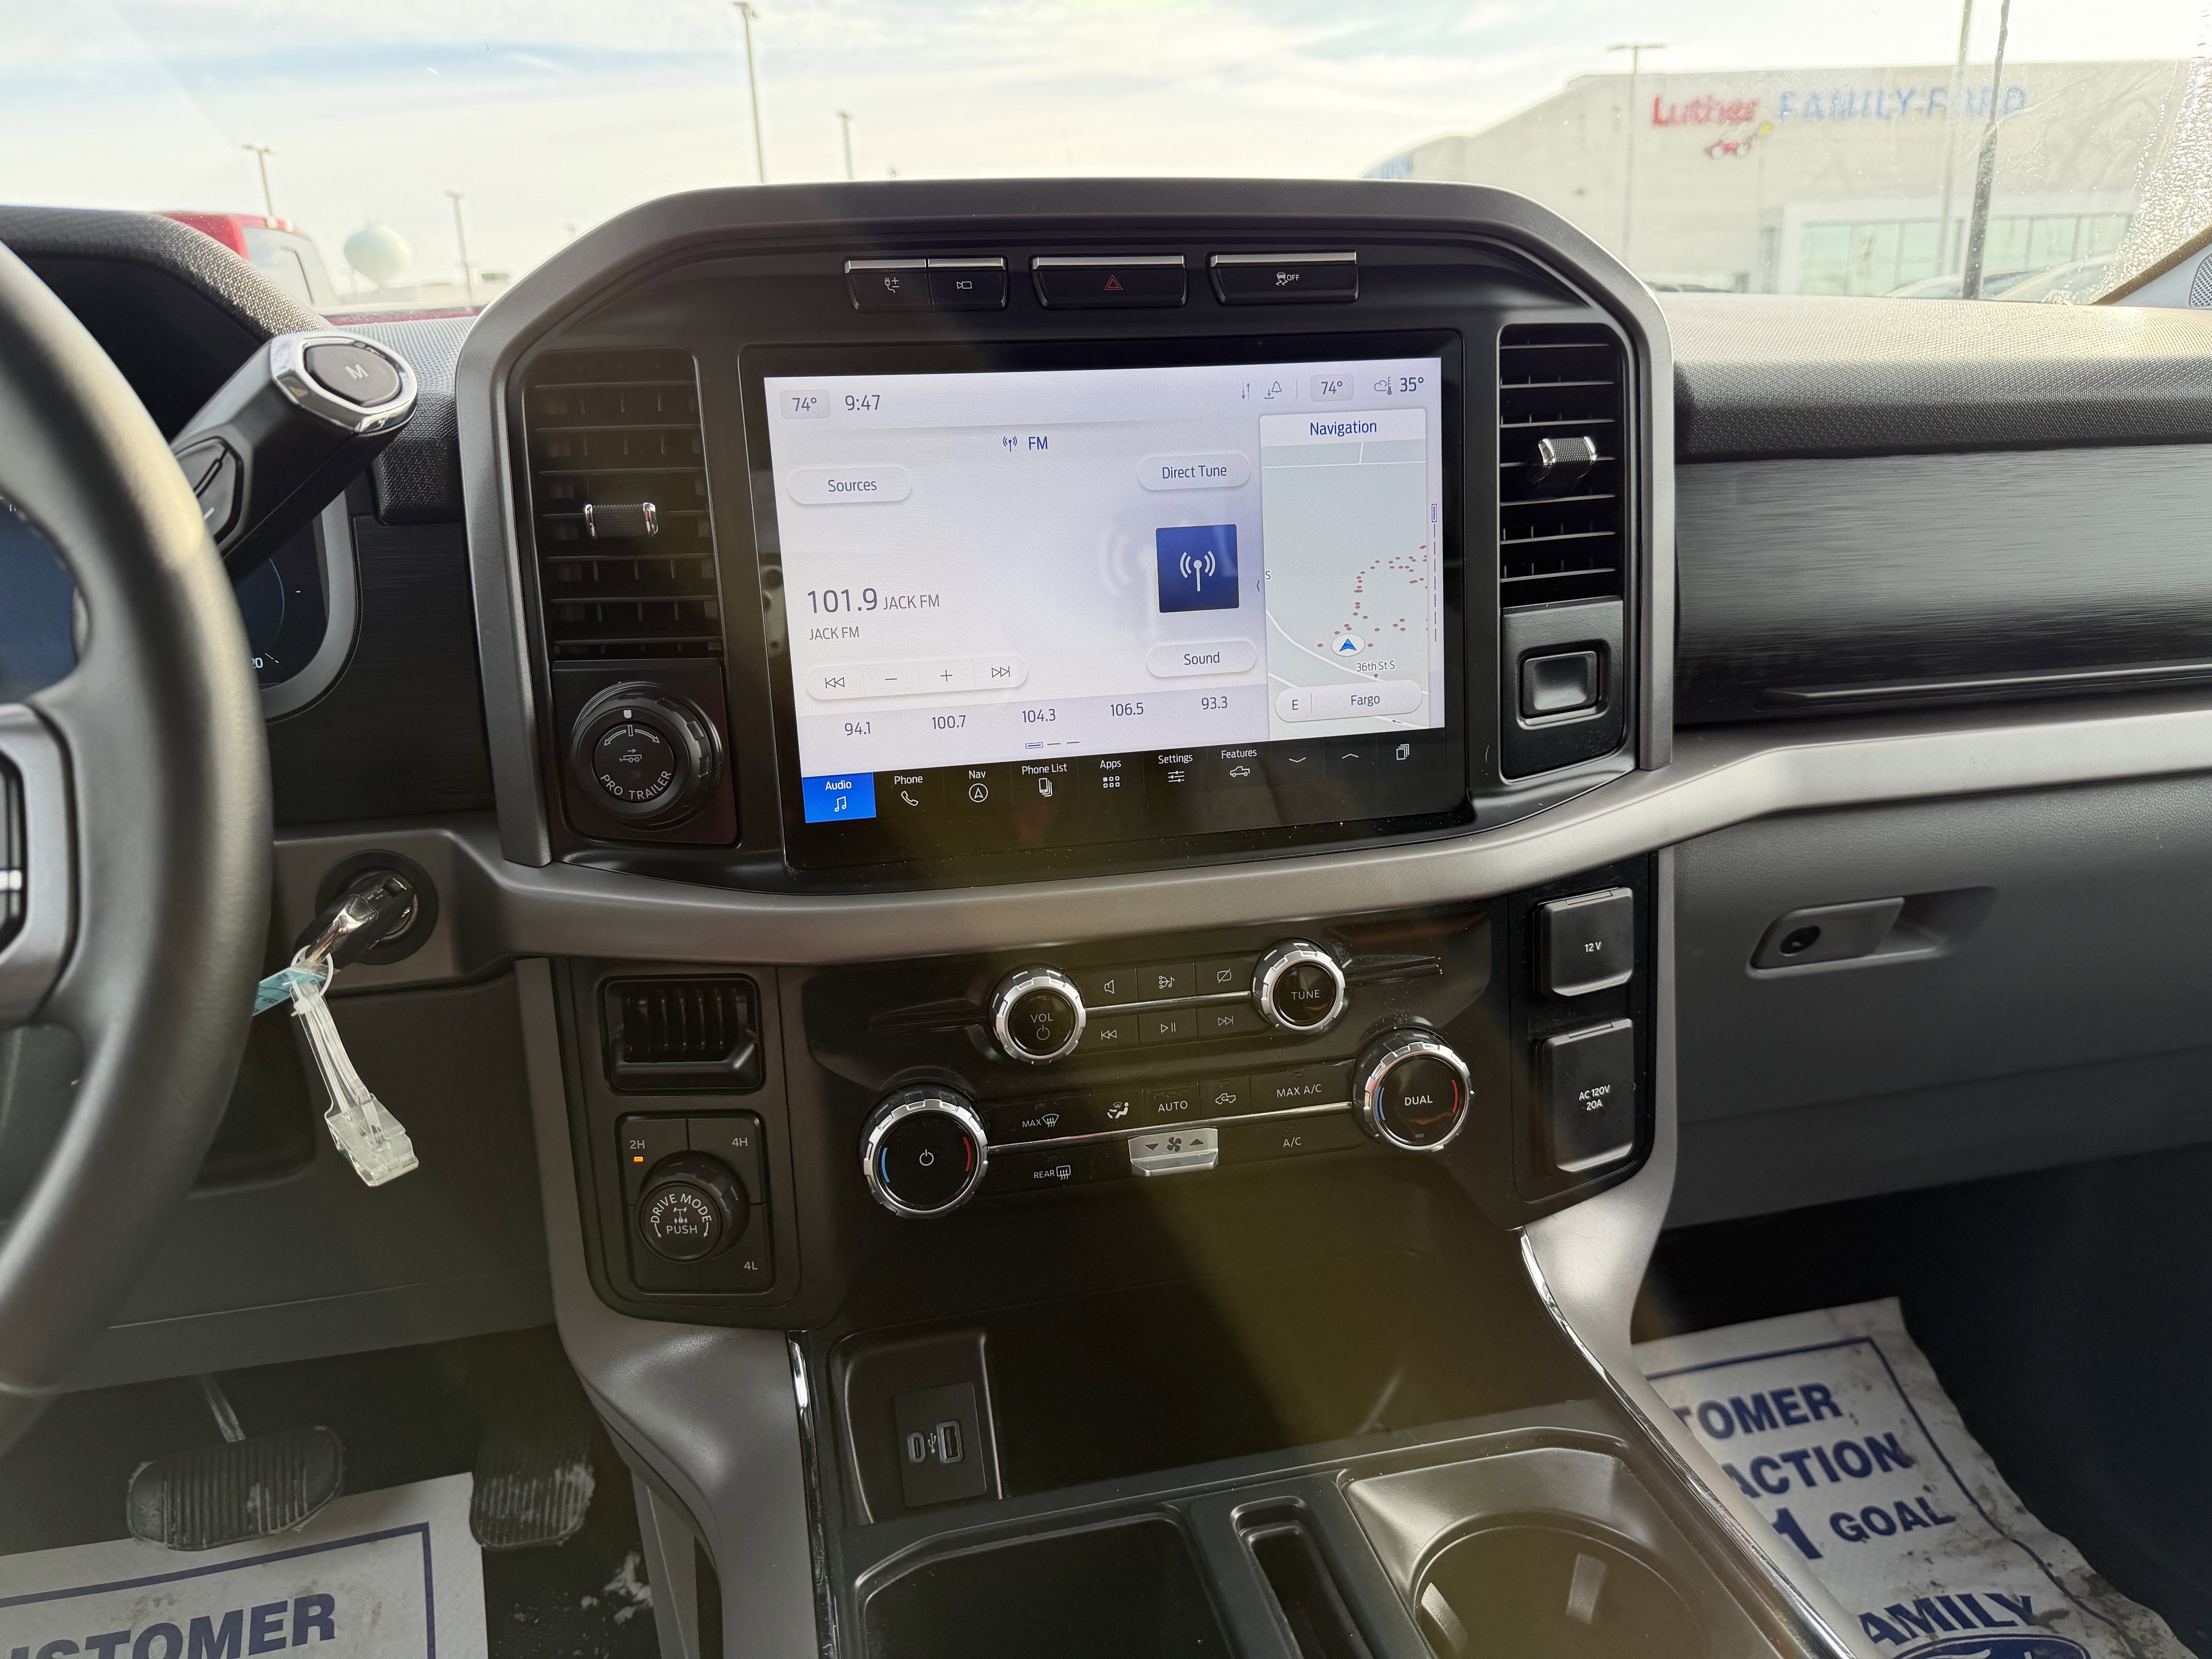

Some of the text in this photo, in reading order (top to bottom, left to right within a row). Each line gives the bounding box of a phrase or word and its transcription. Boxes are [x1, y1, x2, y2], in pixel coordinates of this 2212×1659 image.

[1779, 87, 1915, 121] FAMILY
[1927, 85, 2026, 117] FRD
[345, 364, 368, 379] M
[1321, 381, 1343, 395] 74°
[1400, 376, 1424, 392] 35°
[792, 397, 817, 412] 74°
[845, 395, 881, 411] 9:47
[1310, 420, 1377, 436] Navigation
[1029, 436, 1048, 450] FM
[1162, 464, 1227, 480] Direct Tune
[828, 479, 877, 492] Sources
[1265, 570, 1271, 580] S
[808, 588, 939, 613] 101.9 JACK FM
[810, 627, 859, 640] JACK FM
[1184, 652, 1220, 666] Sound
[1356, 660, 1395, 672] 36th St S
[1202, 696, 1228, 710] 93.3
[1292, 699, 1298, 711] E
[1351, 694, 1380, 707] Fargo
[1022, 709, 1056, 723] 104.3
[1110, 702, 1144, 717] 106.5
[845, 721, 871, 736] 94.1
[932, 715, 966, 730] 100.7
[1158, 753, 1193, 765] Settings
[1221, 748, 1257, 759] Features
[1022, 762, 1067, 775] Phone List
[1100, 759, 1121, 771] Apps
[894, 775, 923, 785] Phone
[969, 769, 986, 779] Nav
[601, 771, 672, 799] PRO TRAILER
[825, 780, 852, 791] Audio
[1585, 941, 1602, 952] 12 V
[1291, 989, 1320, 1000] TUNE
[1030, 1013, 1053, 1023] VOL
[1277, 1084, 1322, 1098] MAX A/C
[1579, 1085, 1610, 1100] AC 120V
[1158, 1101, 1188, 1113] AUTO
[1405, 1095, 1433, 1106] DUAL
[1586, 1099, 1602, 1110] 20A
[1022, 1119, 1041, 1127] MAX
[630, 1140, 645, 1149] 2H
[732, 1137, 748, 1147] 4H
[1283, 1136, 1302, 1147] A/C
[1034, 1170, 1055, 1179] REAR
[651, 1193, 712, 1223] DRIVE MODE
[666, 1225, 697, 1234] PUSH
[744, 1261, 758, 1270] 4L
[1721, 1432, 1912, 1498] ACTION
[1829, 1496, 1957, 1543] GOAL
[1858, 1593, 2033, 1645] AMILY
[10, 1593, 335, 1659] TOMER
